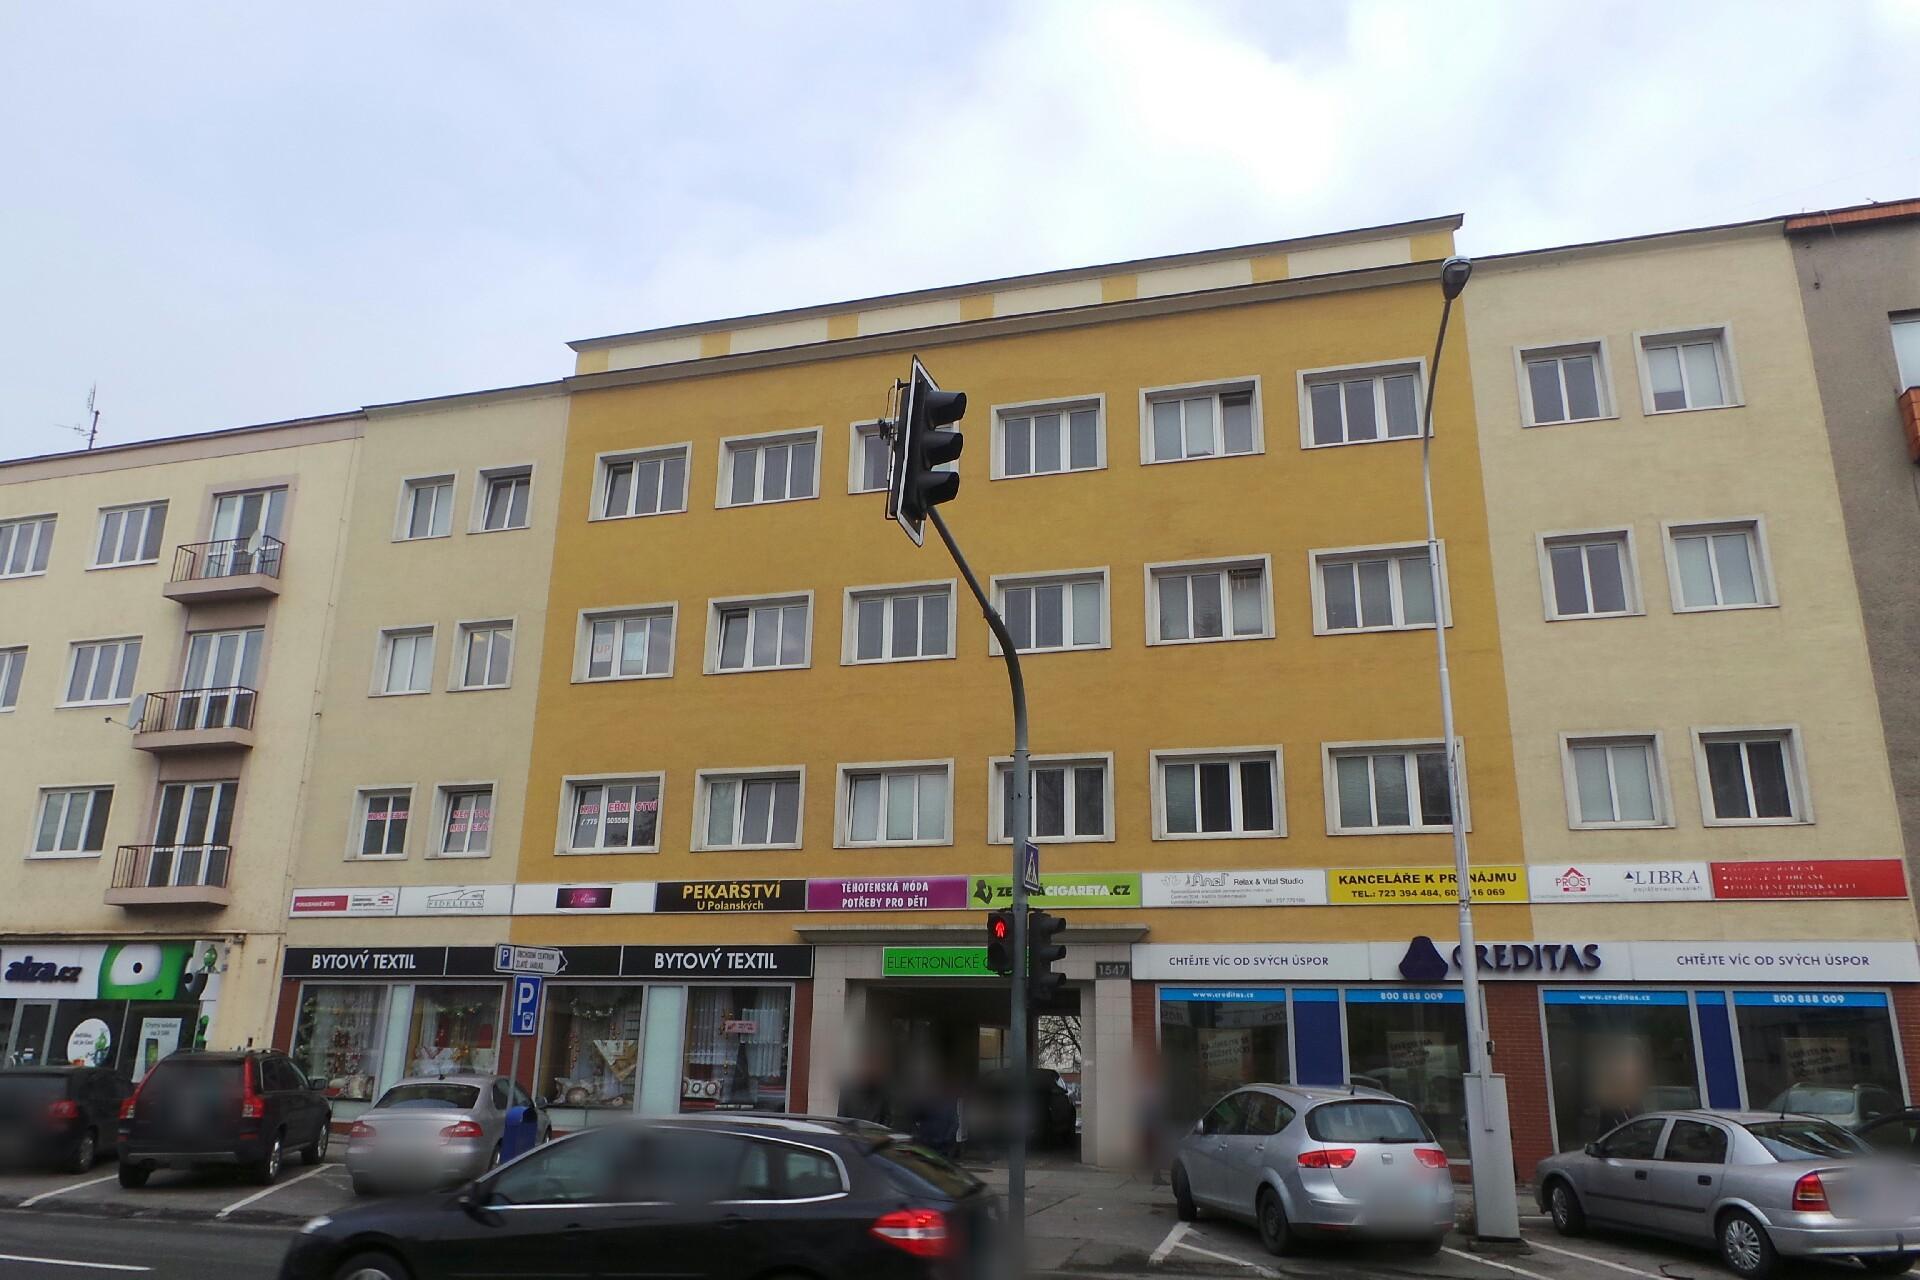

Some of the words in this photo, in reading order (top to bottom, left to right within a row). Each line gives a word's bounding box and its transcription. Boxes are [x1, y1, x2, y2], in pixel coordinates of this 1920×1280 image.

[1233, 878, 1253, 886] Relax
[1255, 878, 1261, 886] &
[1262, 877, 1278, 885] Vital
[1280, 877, 1304, 885] Studio
[1338, 872, 1420, 884] KANCELÁŘE
[1424, 874, 1435, 883] K
[1439, 871, 1517, 883] PRNÁJMU
[1555, 876, 1592, 887] PROST
[1634, 870, 1700, 885] LIBRA
[682, 880, 781, 899] PEKAŘSTVÍ
[841, 881, 899, 893] TĚHOTENSKÁ
[902, 880, 929, 892] MÓDA
[1352, 890, 1376, 898] TEL.:
[1378, 889, 1396, 897] 723
[1399, 889, 1418, 897] 394
[1420, 889, 1442, 898] 484,
[1467, 888, 1484, 896] 16
[1486, 888, 1505, 896] 069
[697, 901, 705, 911] U
[707, 900, 764, 911] Polanských
[842, 895, 883, 908] POTŘEBY
[885, 897, 904, 908] PRO
[907, 894, 928, 908] DĚTI
[311, 949, 369, 969] BYTOVÝ
[372, 954, 417, 969] TEXTIL
[654, 947, 723, 969] BYTOVÝ
[726, 953, 778, 969] TEXTIL
[887, 953, 979, 969] ELEKTRONICKÉ
[1169, 954, 1210, 966] CHTĚJTE
[1214, 954, 1231, 966] VÍC
[1233, 957, 1250, 966] OD
[1253, 954, 1288, 966] SVÝCH
[1292, 954, 1329, 966] ÚSPOR
[1676, 953, 1725, 966] CHTĚJTE
[1728, 953, 1751, 966] VÍC
[1754, 955, 1774, 966] OD
[1779, 953, 1820, 966] SVÝCH
[1825, 953, 1870, 966] ÚSPOR
[1099, 964, 1126, 976] 1547
[517, 982, 535, 1017] P
[1380, 992, 1400, 1001] 800
[1402, 992, 1421, 1001] 888
[1424, 992, 1444, 1001] 009
[1773, 994, 1794, 1004] 800
[1797, 994, 1819, 1004] 888
[1822, 994, 1845, 1004] 009
